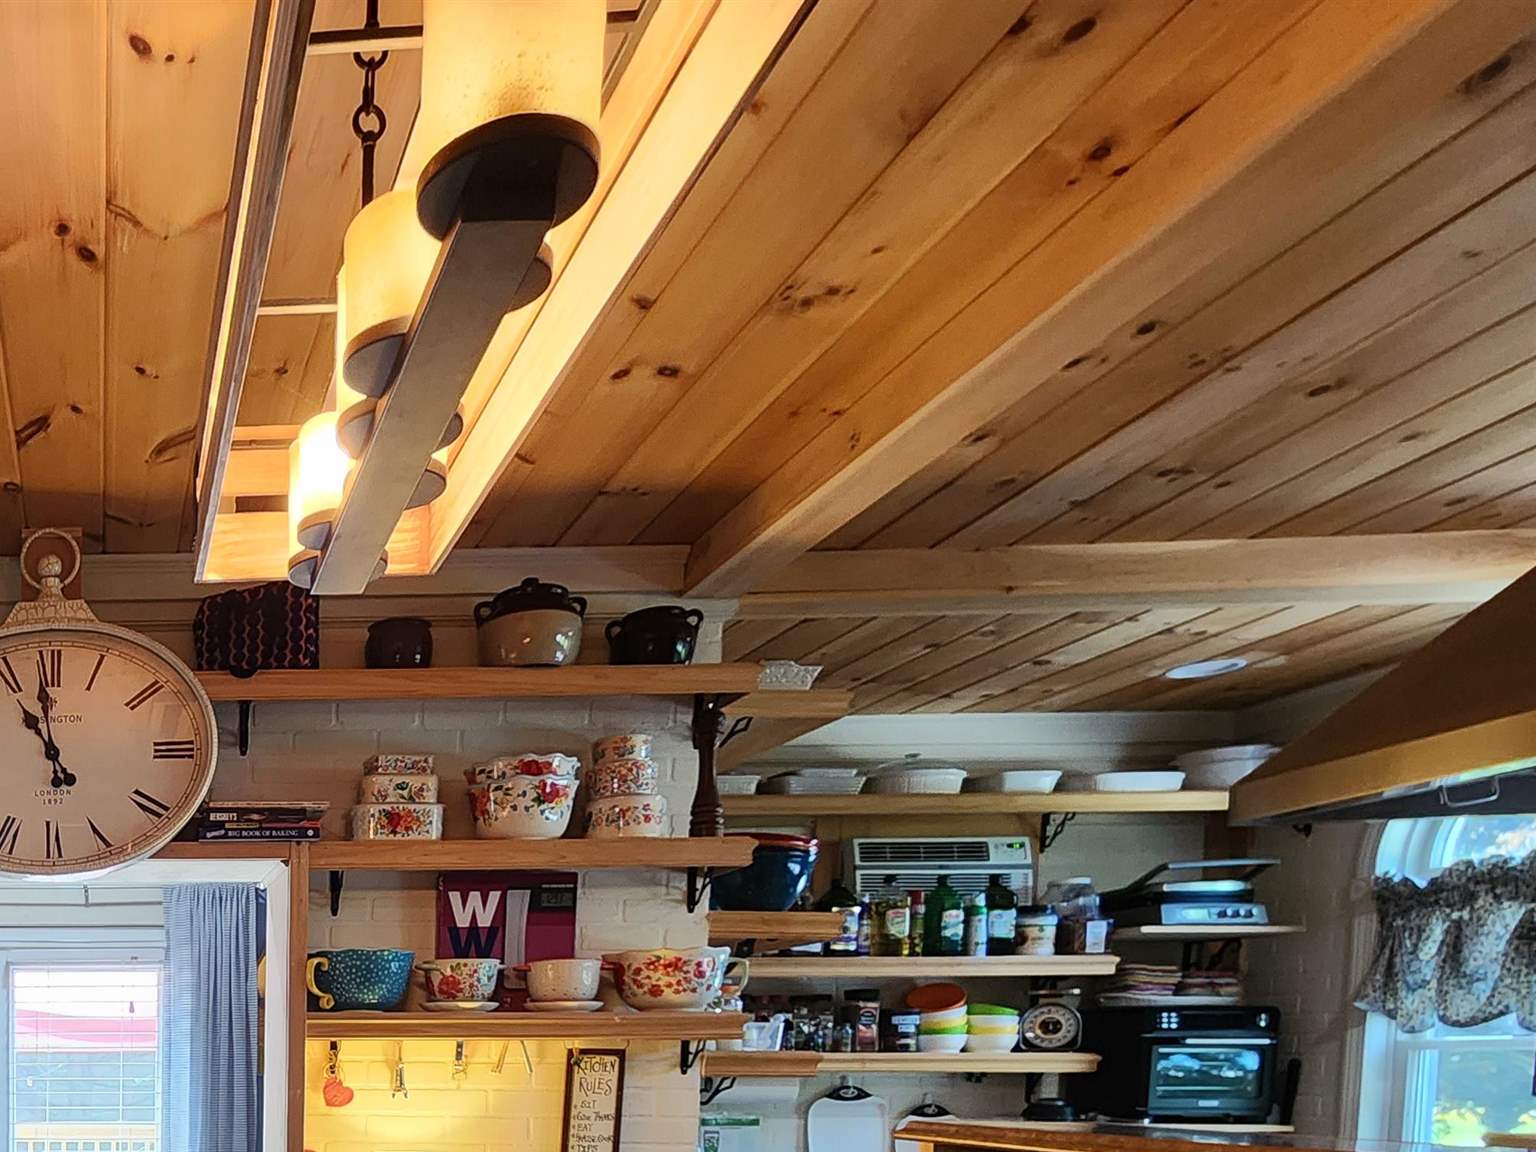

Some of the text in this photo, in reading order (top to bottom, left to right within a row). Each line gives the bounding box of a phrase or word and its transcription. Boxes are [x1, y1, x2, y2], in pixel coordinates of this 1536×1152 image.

[34, 789, 72, 797] LONDON
[227, 829, 241, 837] BIG
[241, 829, 262, 837] BOOK
[262, 829, 271, 837] OF
[271, 829, 299, 837] BAKING
[447, 890, 502, 928] W
[576, 1056, 617, 1075] KITCHEN
[579, 1077, 613, 1097] RULES
